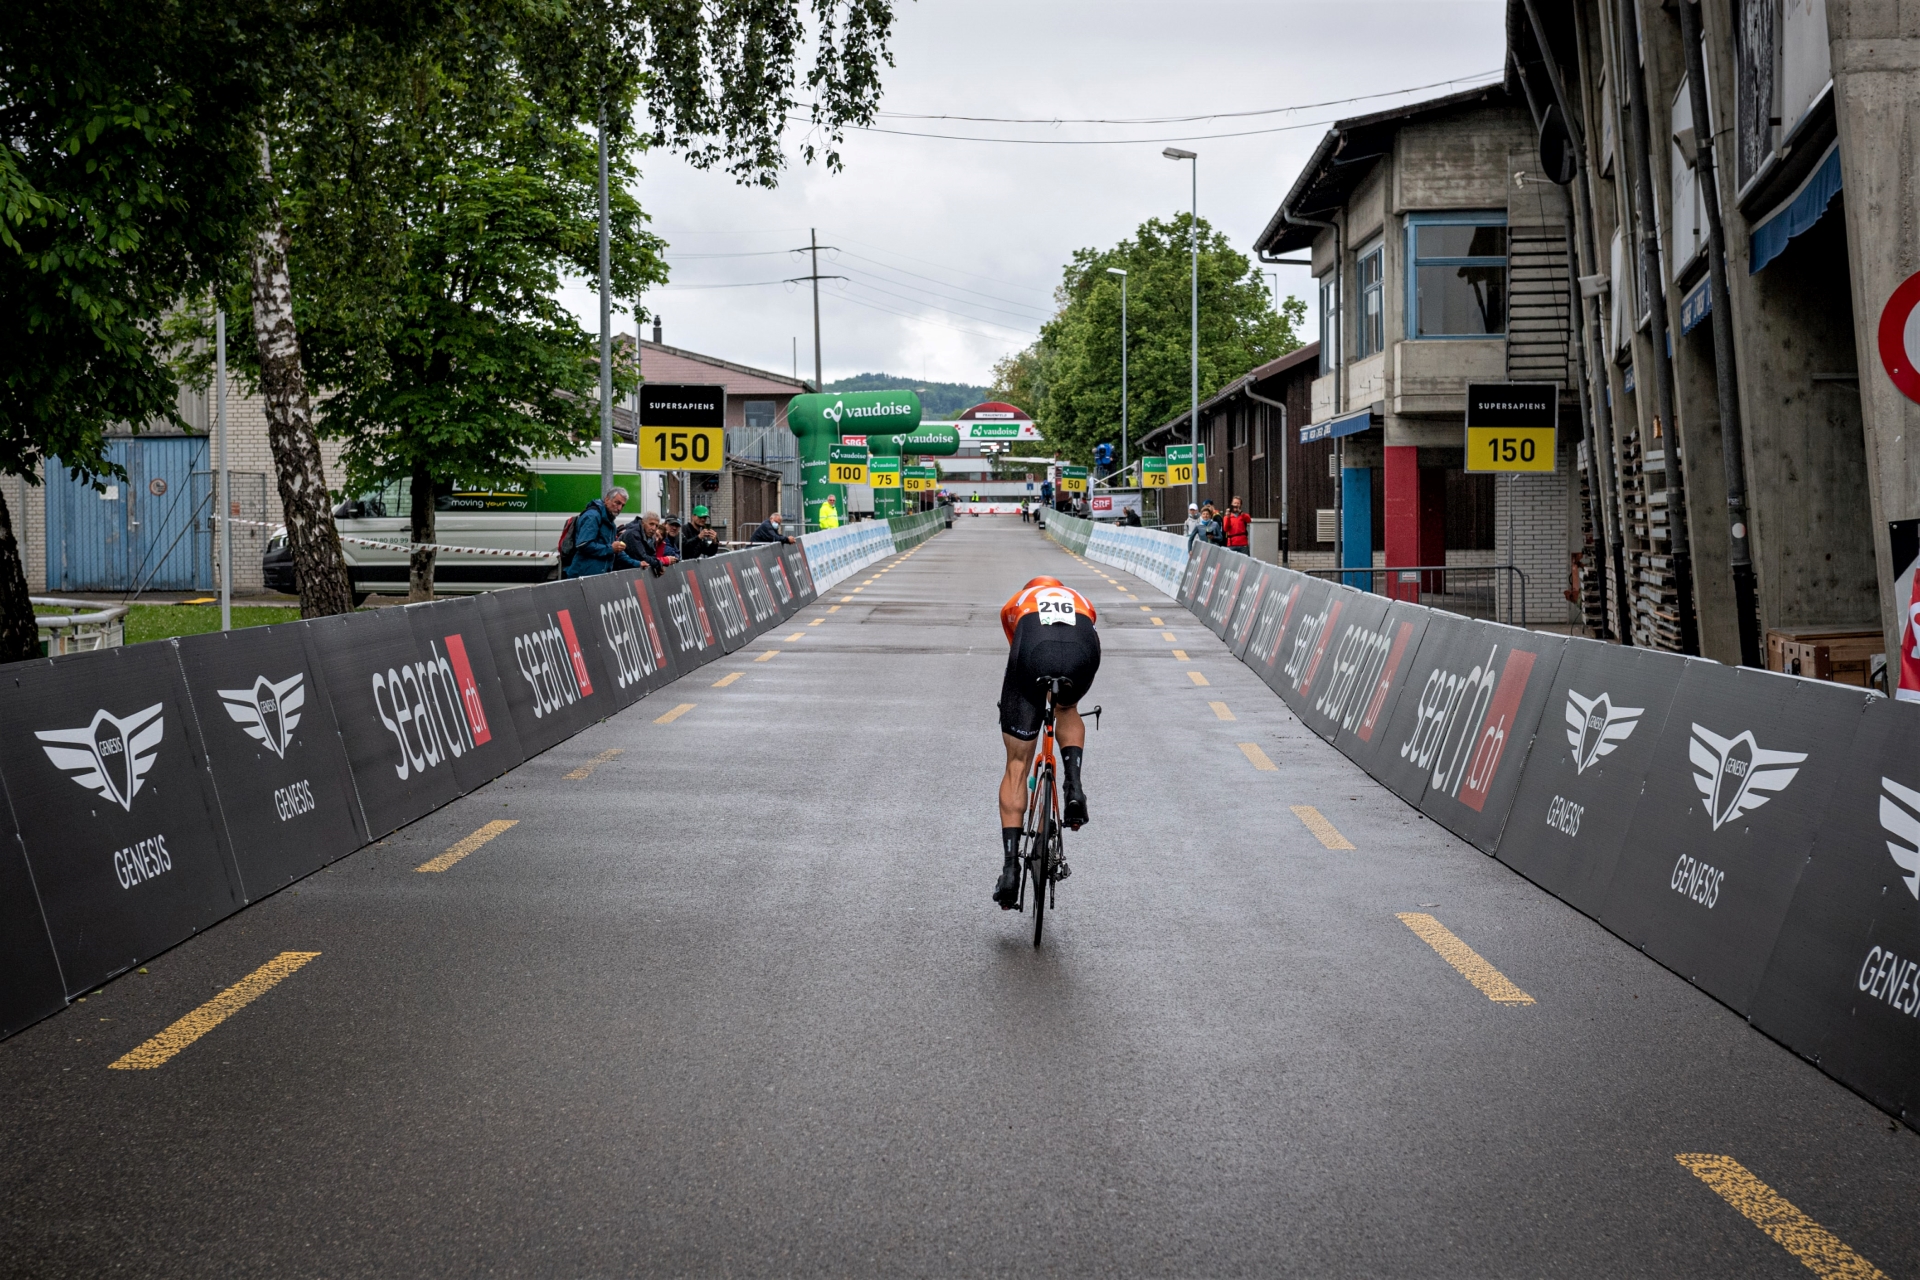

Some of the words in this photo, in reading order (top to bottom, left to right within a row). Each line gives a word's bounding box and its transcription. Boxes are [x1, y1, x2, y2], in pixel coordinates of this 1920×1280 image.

[649, 402, 715, 410] SUPERSAPIENS
[845, 402, 911, 418] vaudoise
[1478, 402, 1546, 410] SUPERSAPIENS
[983, 426, 1018, 436] vaudoise
[907, 433, 954, 443] vaudoise
[655, 432, 710, 462] 150
[1488, 438, 1535, 462] 150
[836, 466, 861, 481] 100
[878, 474, 892, 485] 75
[1151, 474, 1165, 485] 75
[907, 480, 919, 489] 50
[926, 480, 932, 489] 5
[1068, 480, 1080, 490] 50
[451, 500, 484, 508] moving
[508, 501, 528, 509] way
[1093, 500, 1110, 508] SRF
[1039, 601, 1074, 613] 216
[260, 699, 277, 714] GENESIS
[1588, 715, 1605, 730] GENESIS
[99, 736, 123, 757] GENESIS
[1725, 757, 1749, 777] GENESIS
[274, 779, 315, 821] GENESIS
[1546, 794, 1585, 837] GENESIS
[114, 834, 172, 889] GENESIS
[1671, 853, 1725, 909] GENESIS
